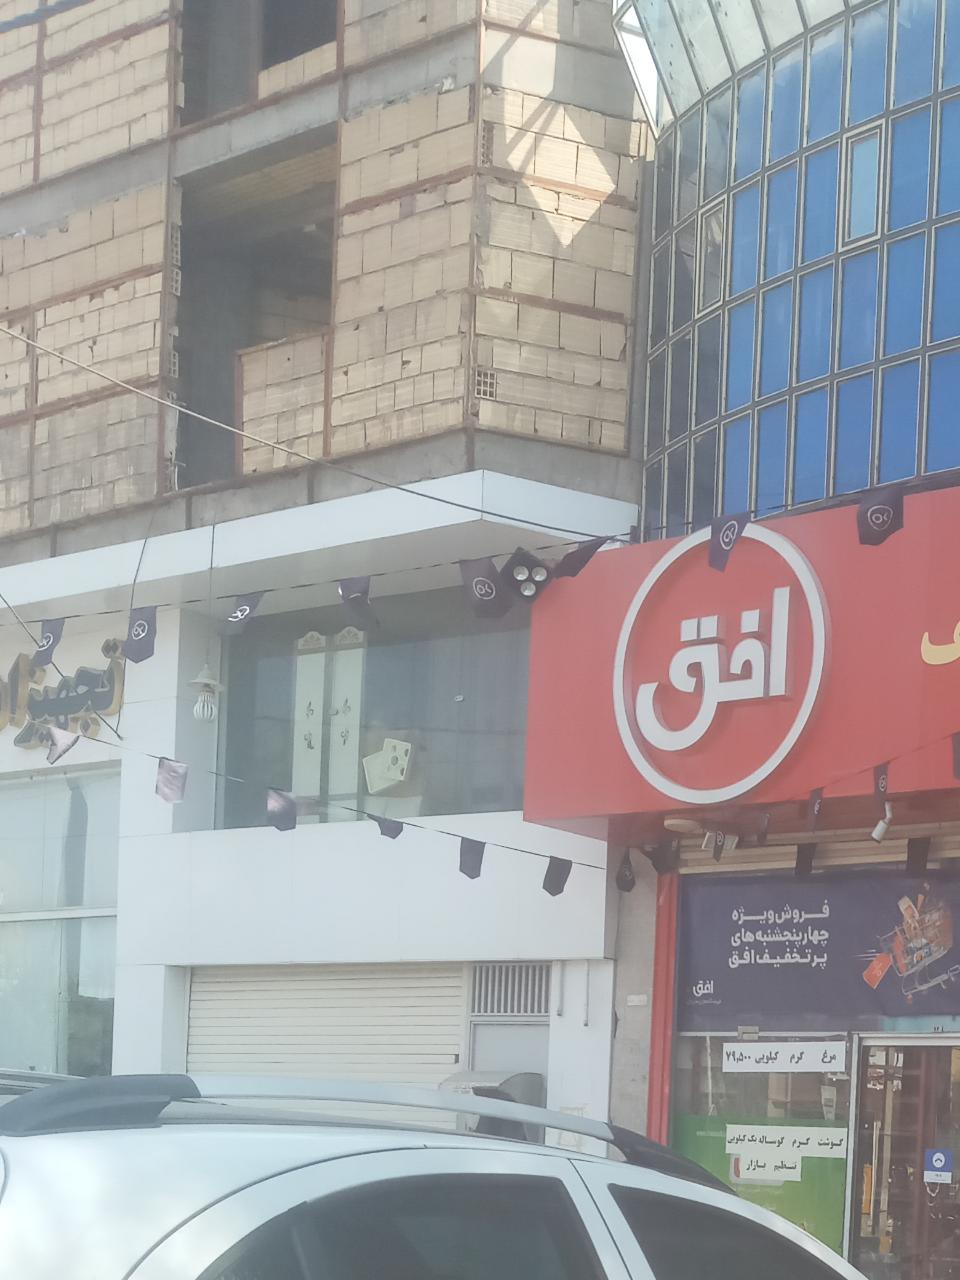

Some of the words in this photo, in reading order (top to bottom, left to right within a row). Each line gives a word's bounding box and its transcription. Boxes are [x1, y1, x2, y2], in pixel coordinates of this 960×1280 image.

[636, 586, 790, 751] افق
[731, 905, 774, 924] ویژه
[775, 899, 830, 924] فروش
[728, 946, 755, 969] افق
[692, 980, 714, 997] افق
[755, 1050, 779, 1064] کیلویی
[789, 1051, 804, 1064] گرم
[821, 1049, 836, 1064] مرغ
[727, 1134, 746, 1144] کیلویی
[759, 1135, 785, 1147] گوساله
[792, 1136, 810, 1148] گرم
[817, 1137, 844, 1149] گوشت
[745, 1159, 767, 1171] بازار
[773, 1160, 797, 1172] تنظیم
